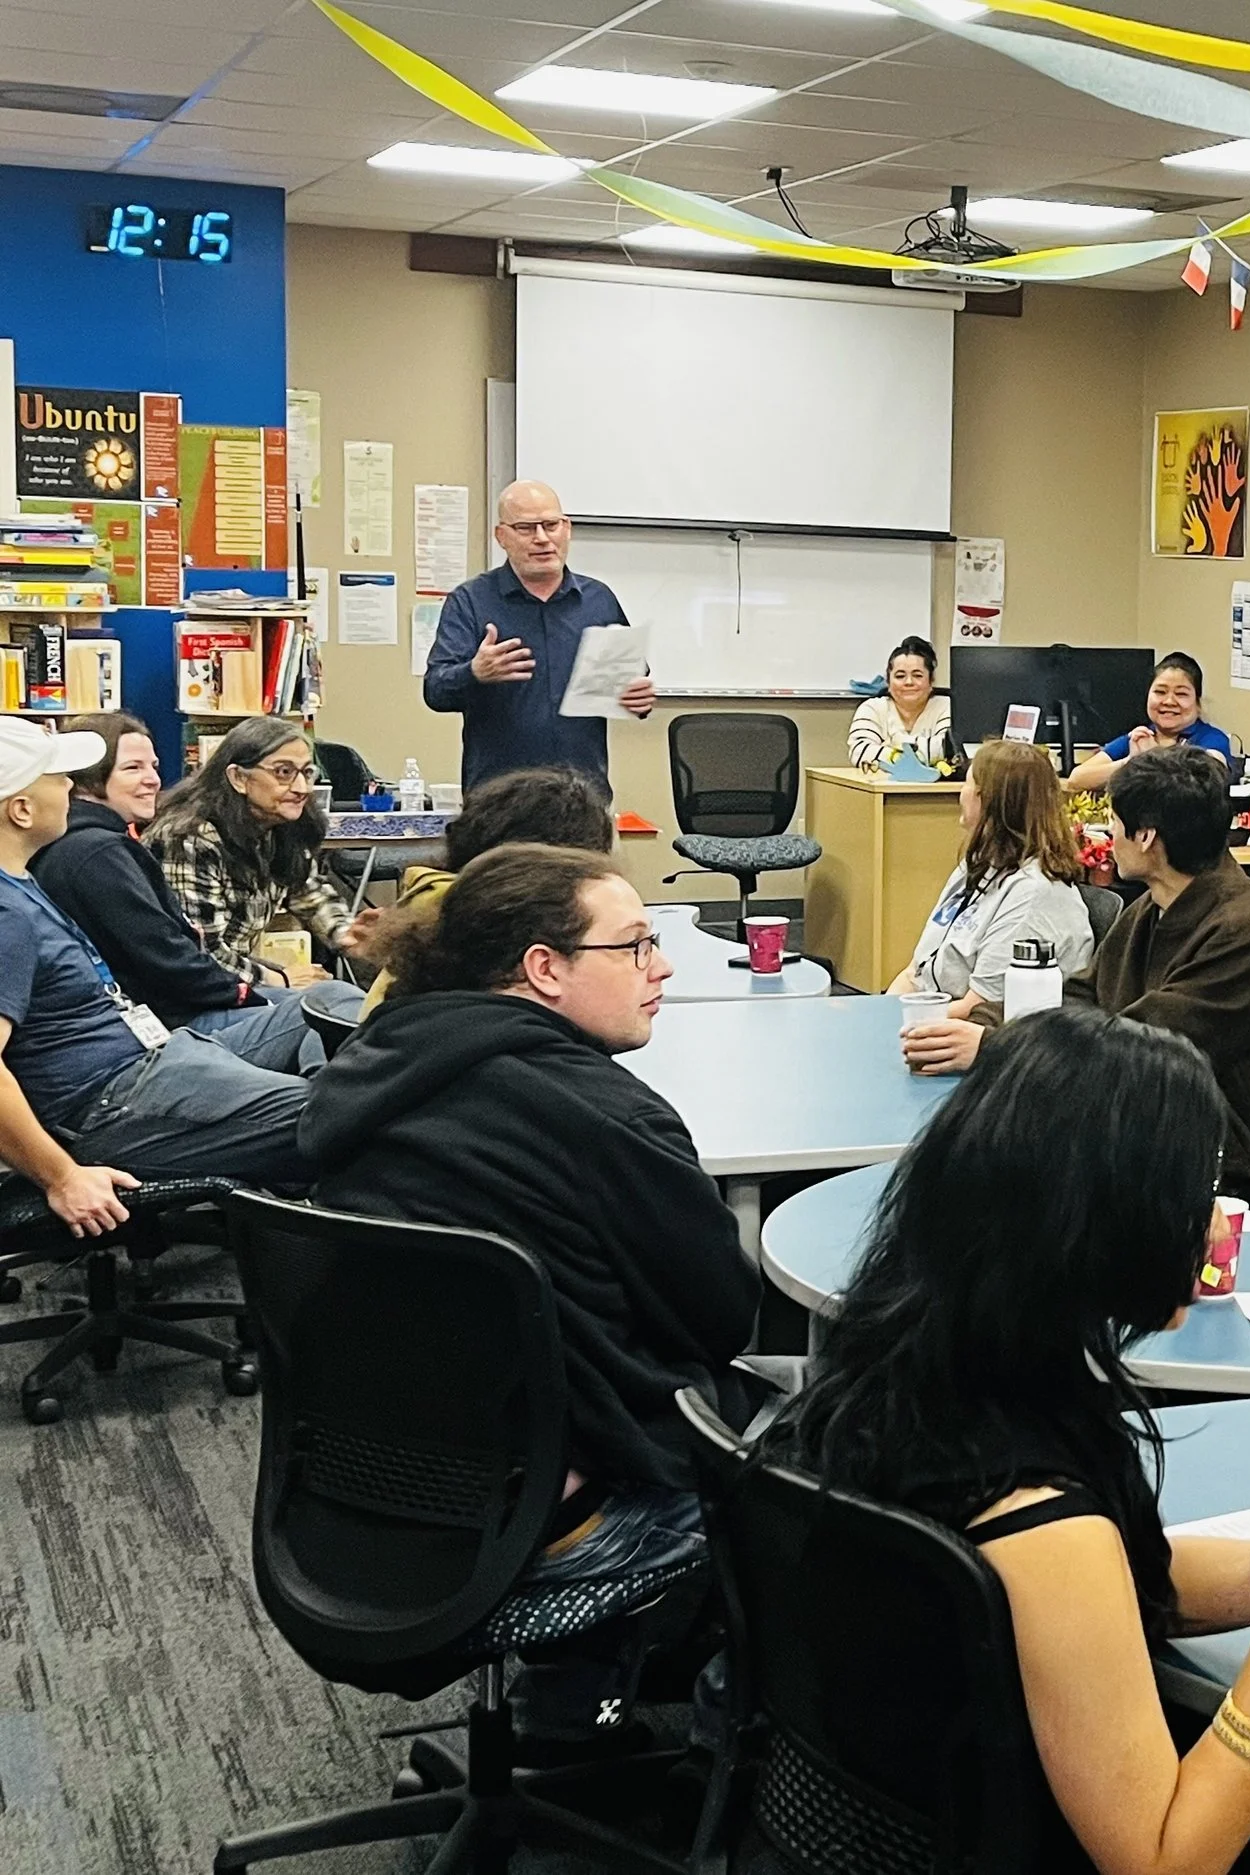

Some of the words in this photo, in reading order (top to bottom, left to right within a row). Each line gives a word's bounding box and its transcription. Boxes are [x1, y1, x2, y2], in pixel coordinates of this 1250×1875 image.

[108, 204, 230, 262] 12:15
[19, 393, 136, 434] Ubuntu
[46, 636, 61, 682] FRENCH
[188, 636, 208, 647] First
[209, 636, 244, 648] Spanish
